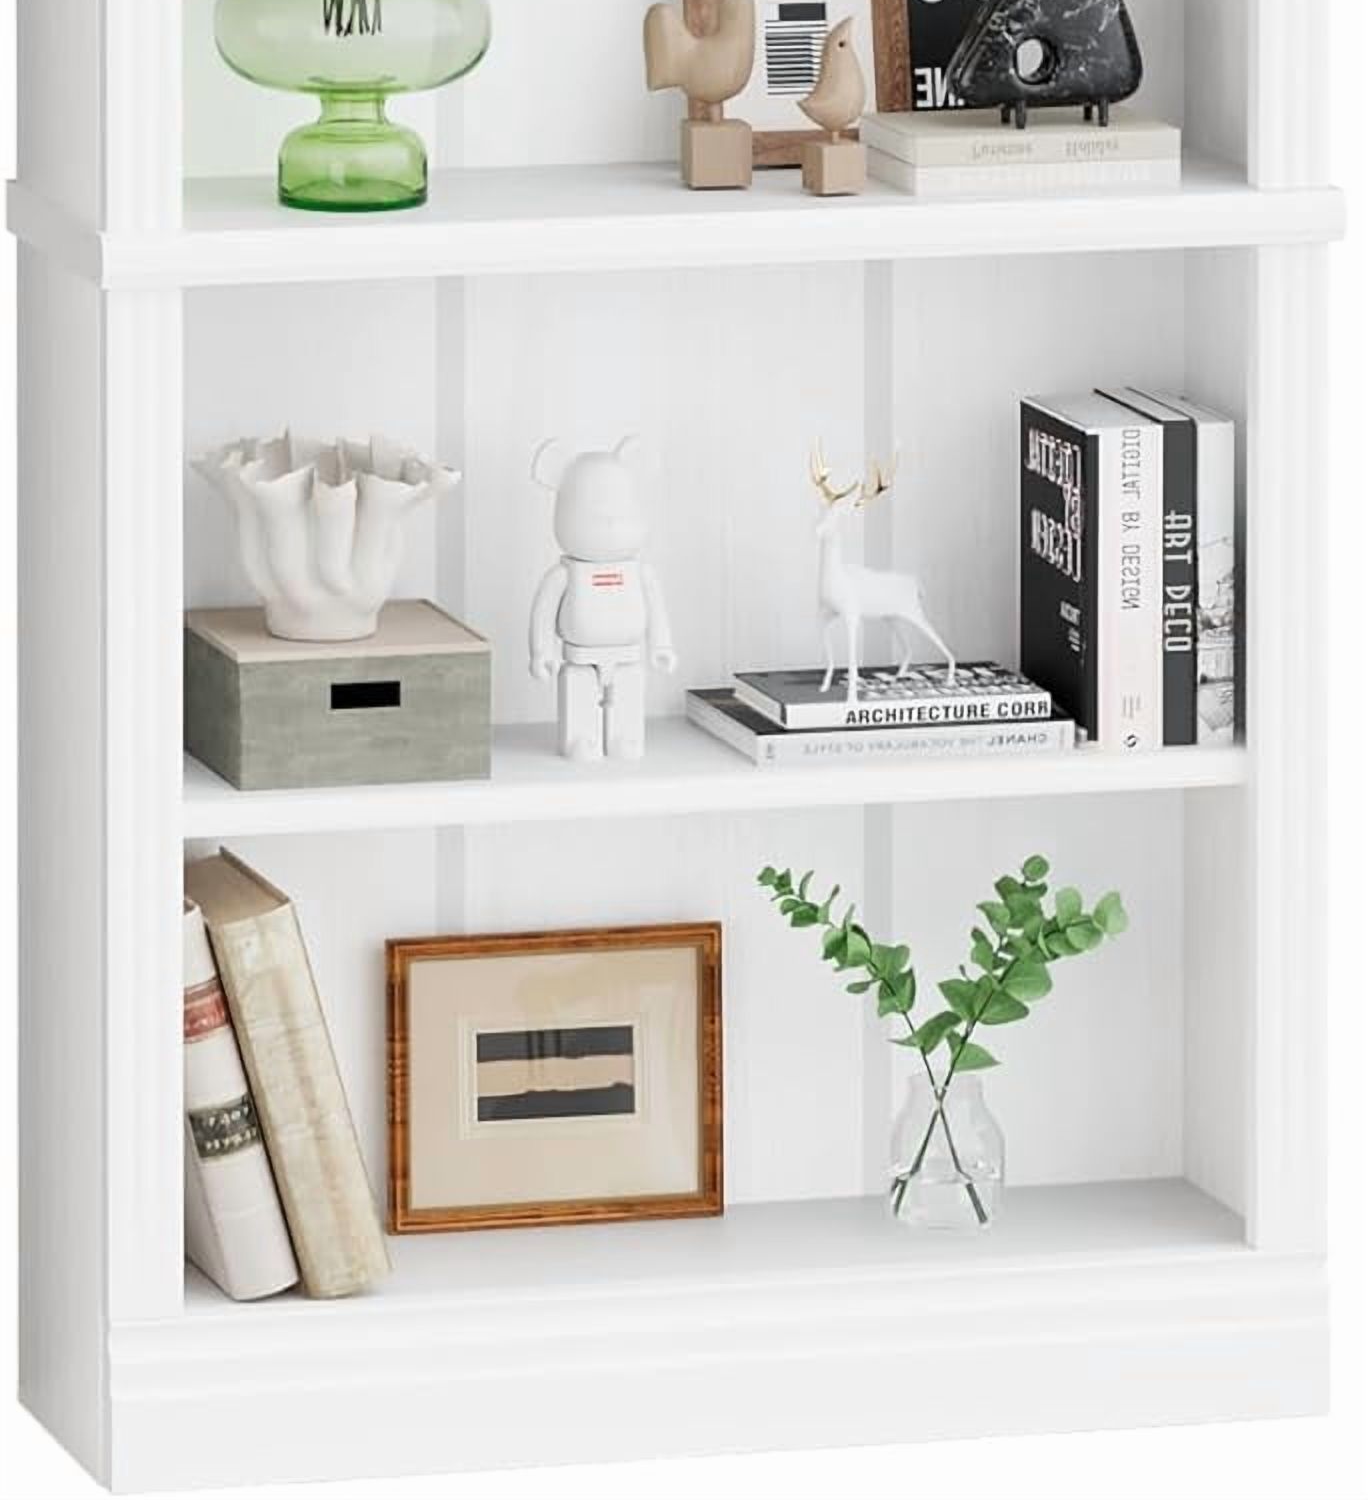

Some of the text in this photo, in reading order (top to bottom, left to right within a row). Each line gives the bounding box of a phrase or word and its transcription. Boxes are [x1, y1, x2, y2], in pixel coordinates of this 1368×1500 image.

[1164, 509, 1193, 652] ART DECO
[845, 702, 990, 725] ARCHITECTURE
